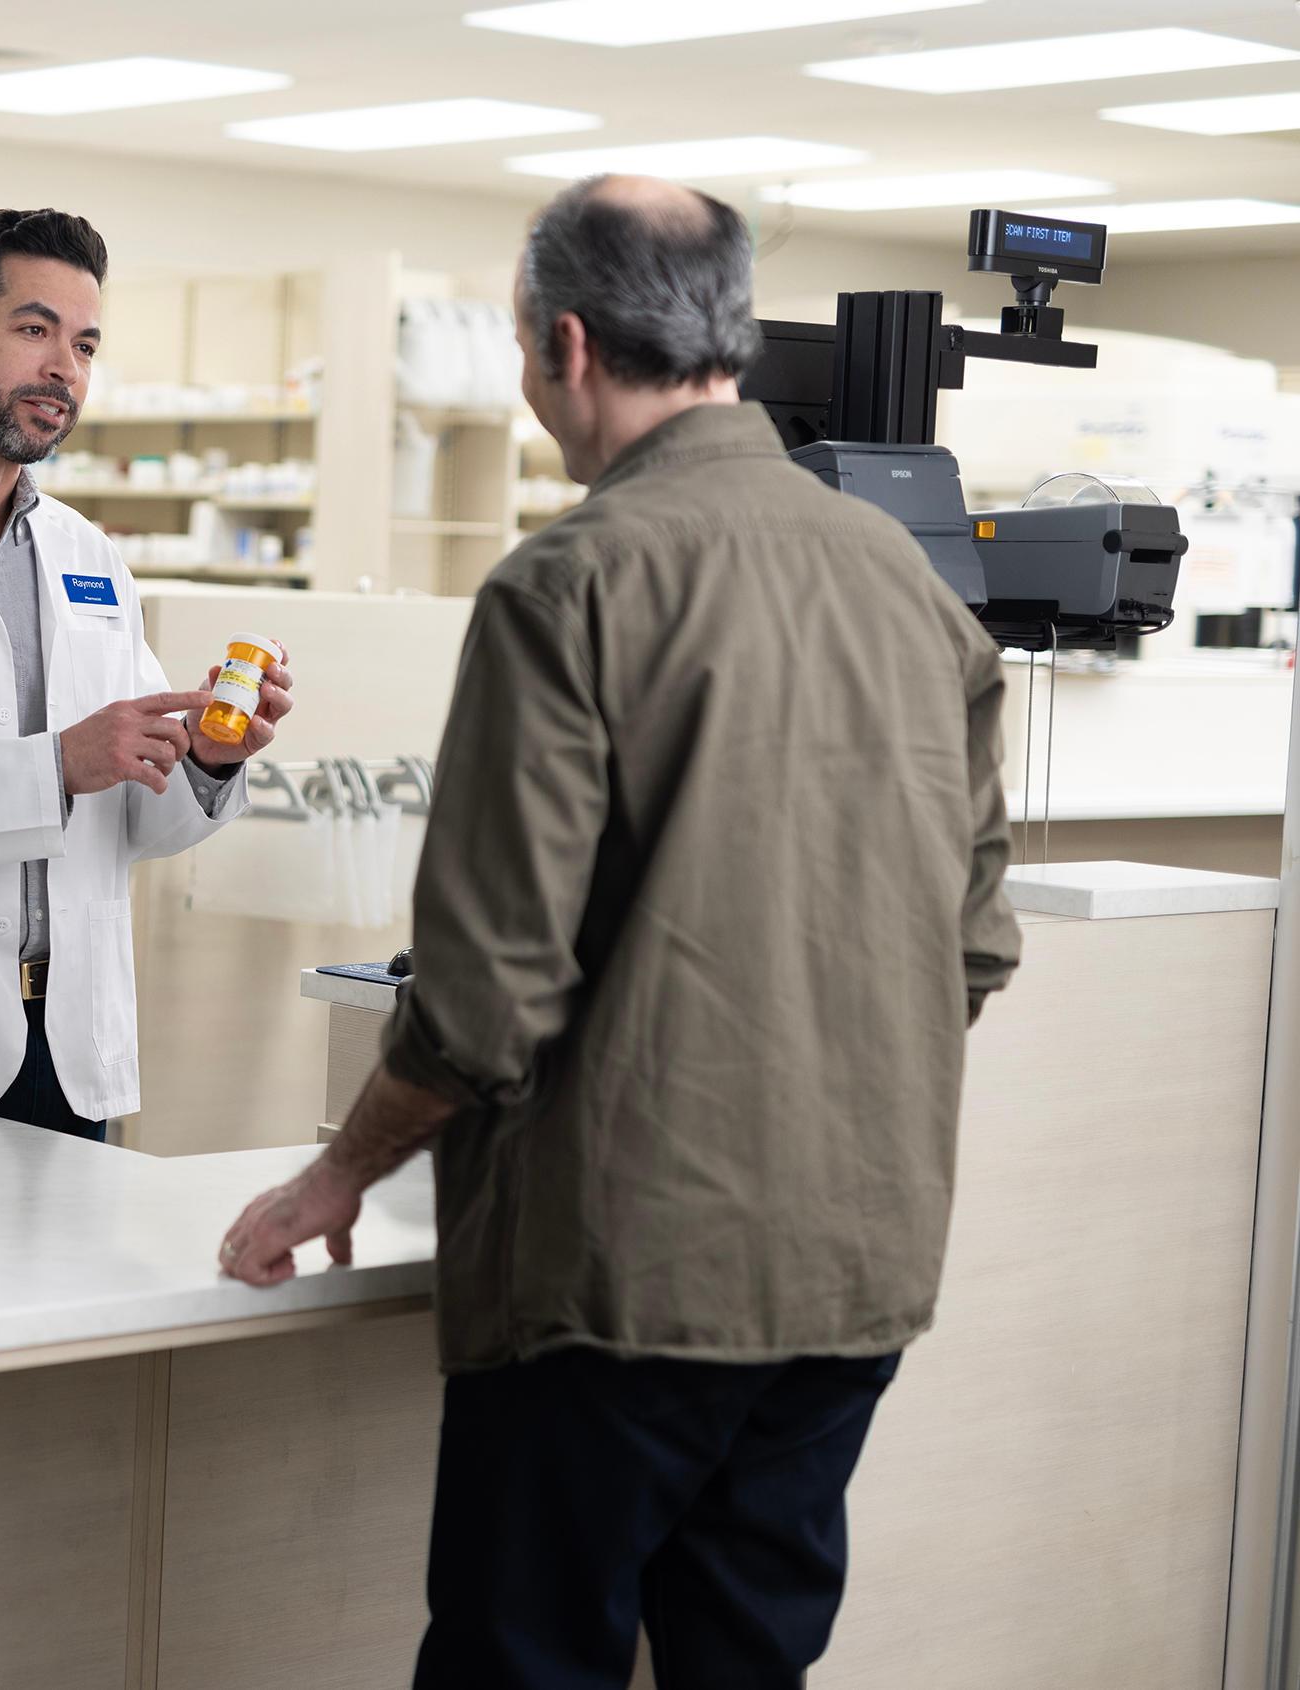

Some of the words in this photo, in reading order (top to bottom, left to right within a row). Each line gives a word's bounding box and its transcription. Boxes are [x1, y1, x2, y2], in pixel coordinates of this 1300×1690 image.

[1005, 223, 1024, 238] SCAN
[1026, 226, 1050, 240] FIRST
[1053, 230, 1072, 243] ITEM
[1038, 266, 1058, 274] TOSHIBA
[891, 470, 912, 478] EPSON
[71, 577, 105, 590] Raymond
